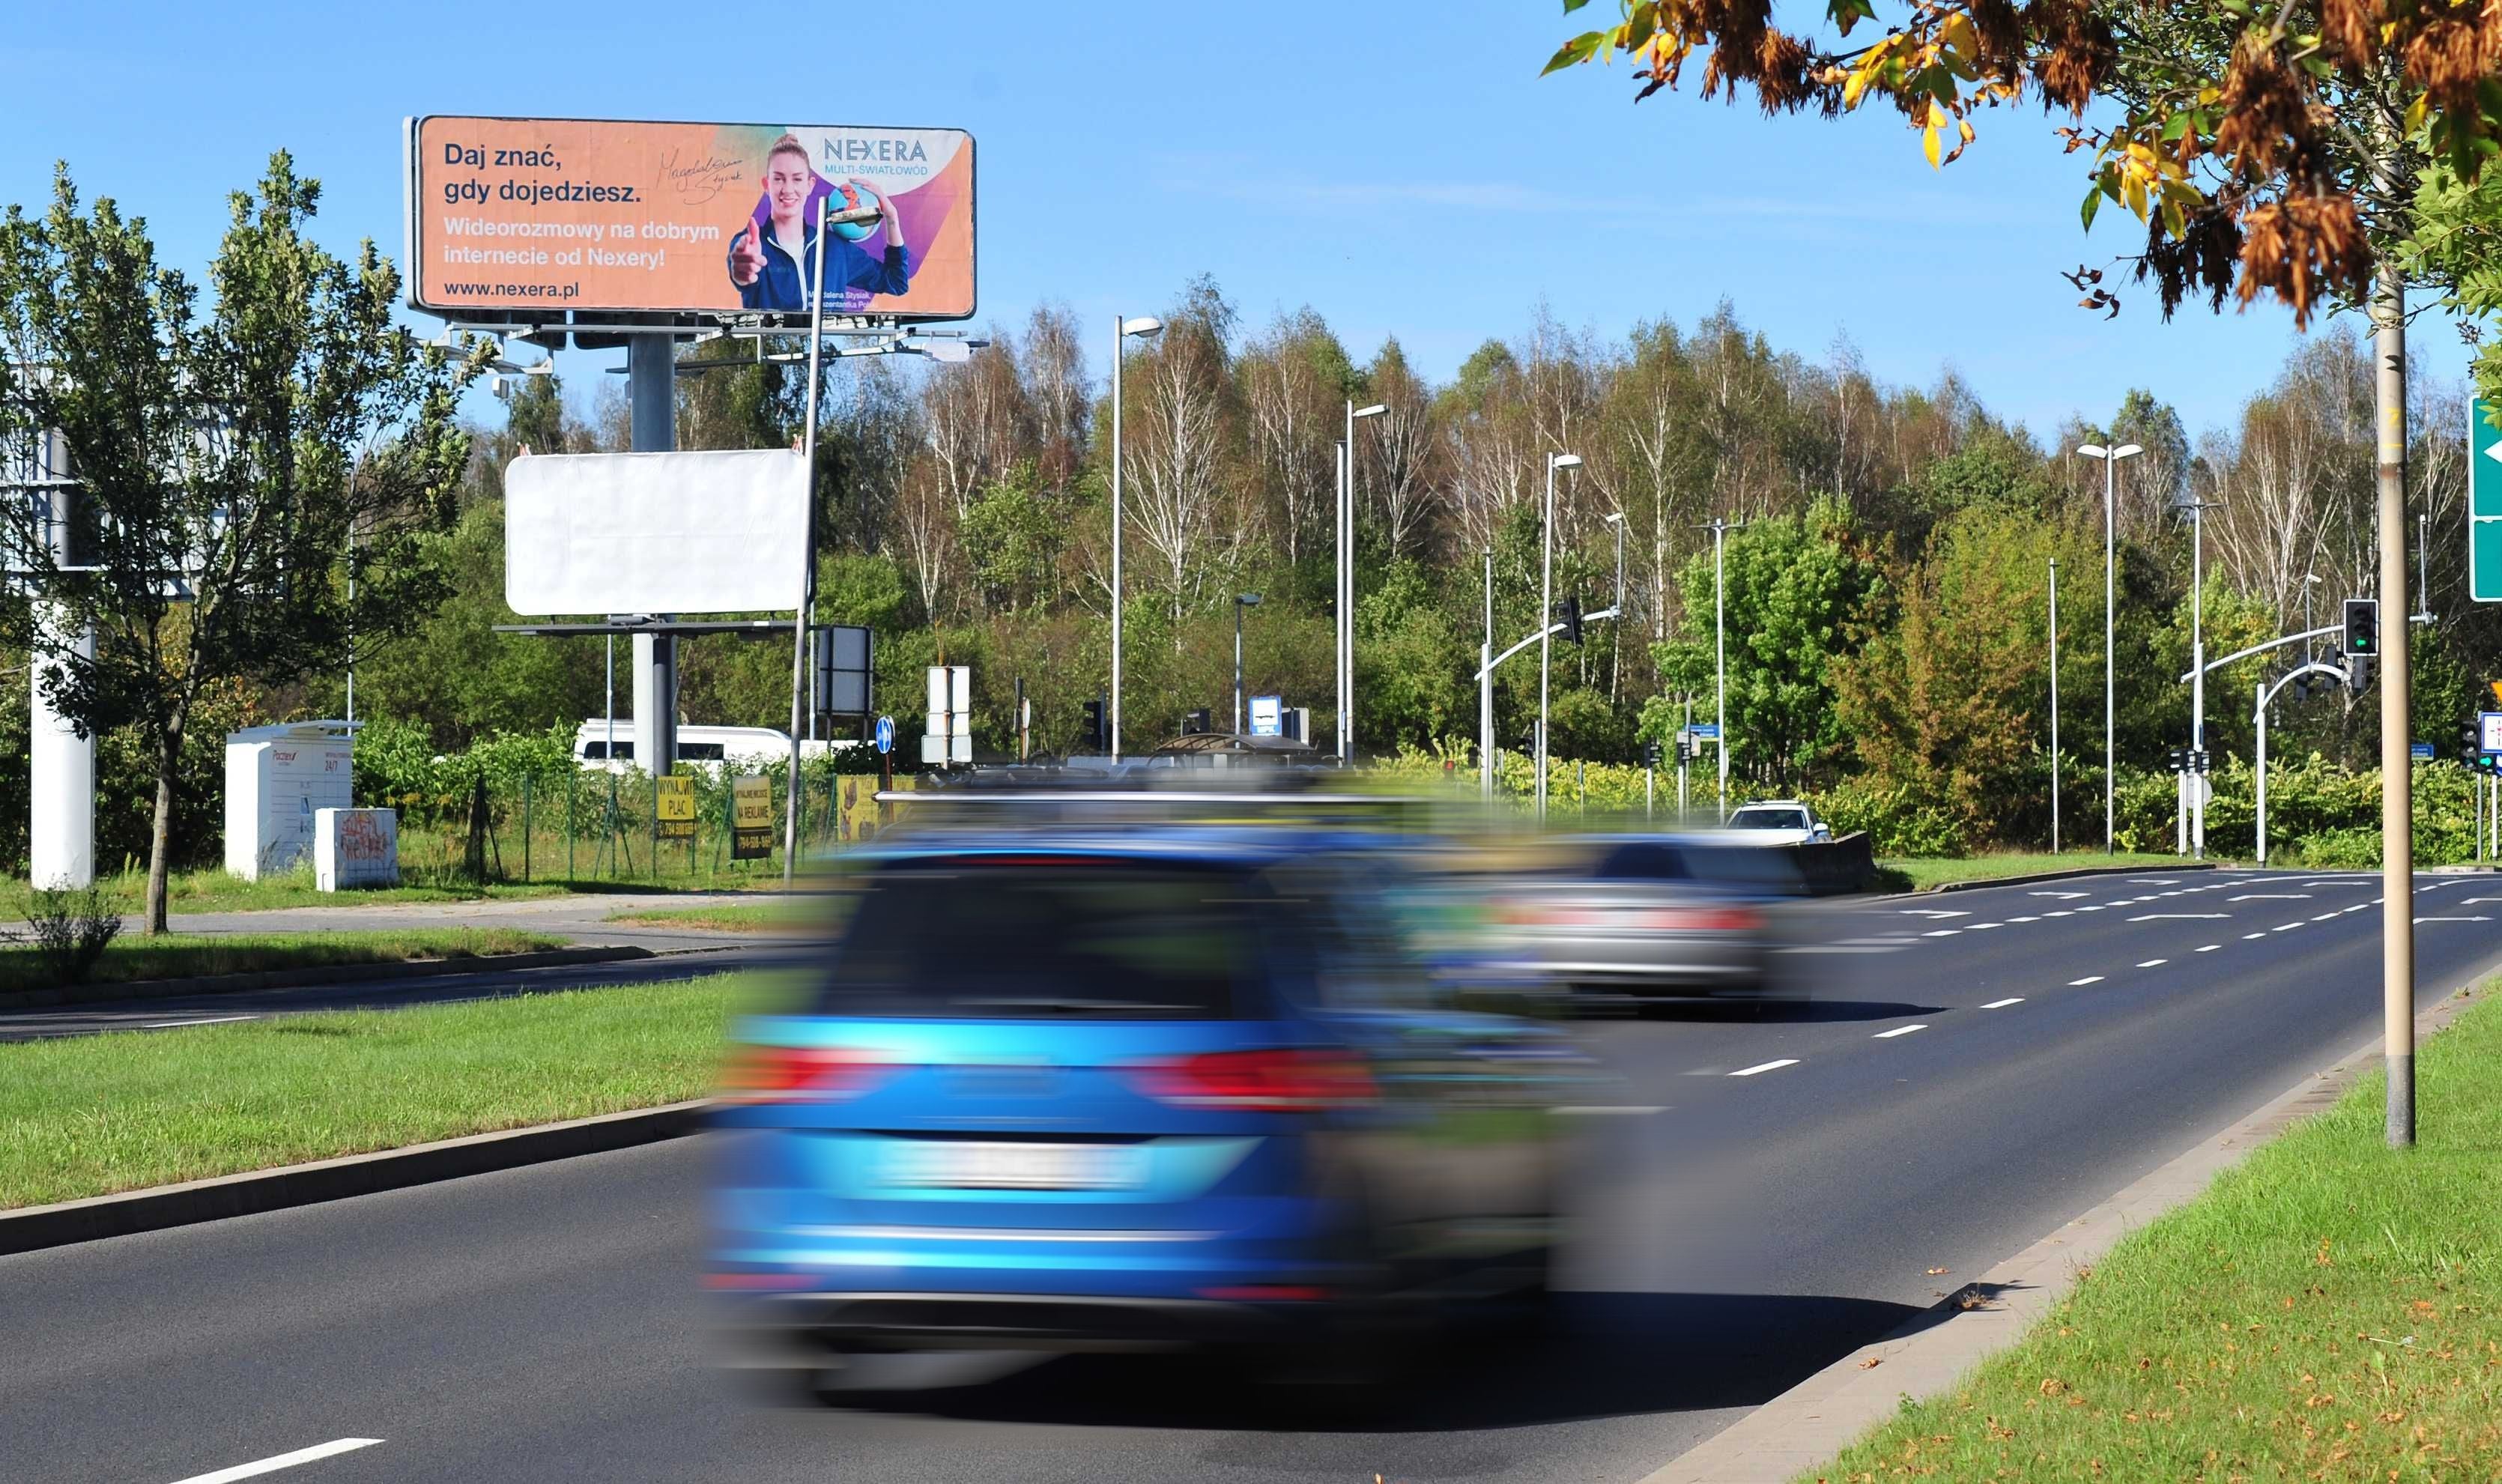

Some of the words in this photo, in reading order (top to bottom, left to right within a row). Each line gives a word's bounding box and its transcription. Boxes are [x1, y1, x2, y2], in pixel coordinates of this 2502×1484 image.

[444, 143, 485, 170] Daj
[494, 144, 561, 171] znać,
[825, 138, 927, 161] NEXERA
[825, 164, 928, 176] MULTI-ŚWIATŁOWÓD
[444, 178, 491, 205] gdy
[499, 180, 641, 205] dojedziesz.
[443, 217, 605, 242] Wideorozmowy
[611, 224, 635, 239] na
[642, 222, 720, 243] dobrym
[443, 245, 548, 265] internecie
[555, 248, 581, 265] od
[588, 249, 665, 270] Nexery!
[444, 282, 580, 300] www.nexera.pl
[669, 799, 686, 816] PLAC
